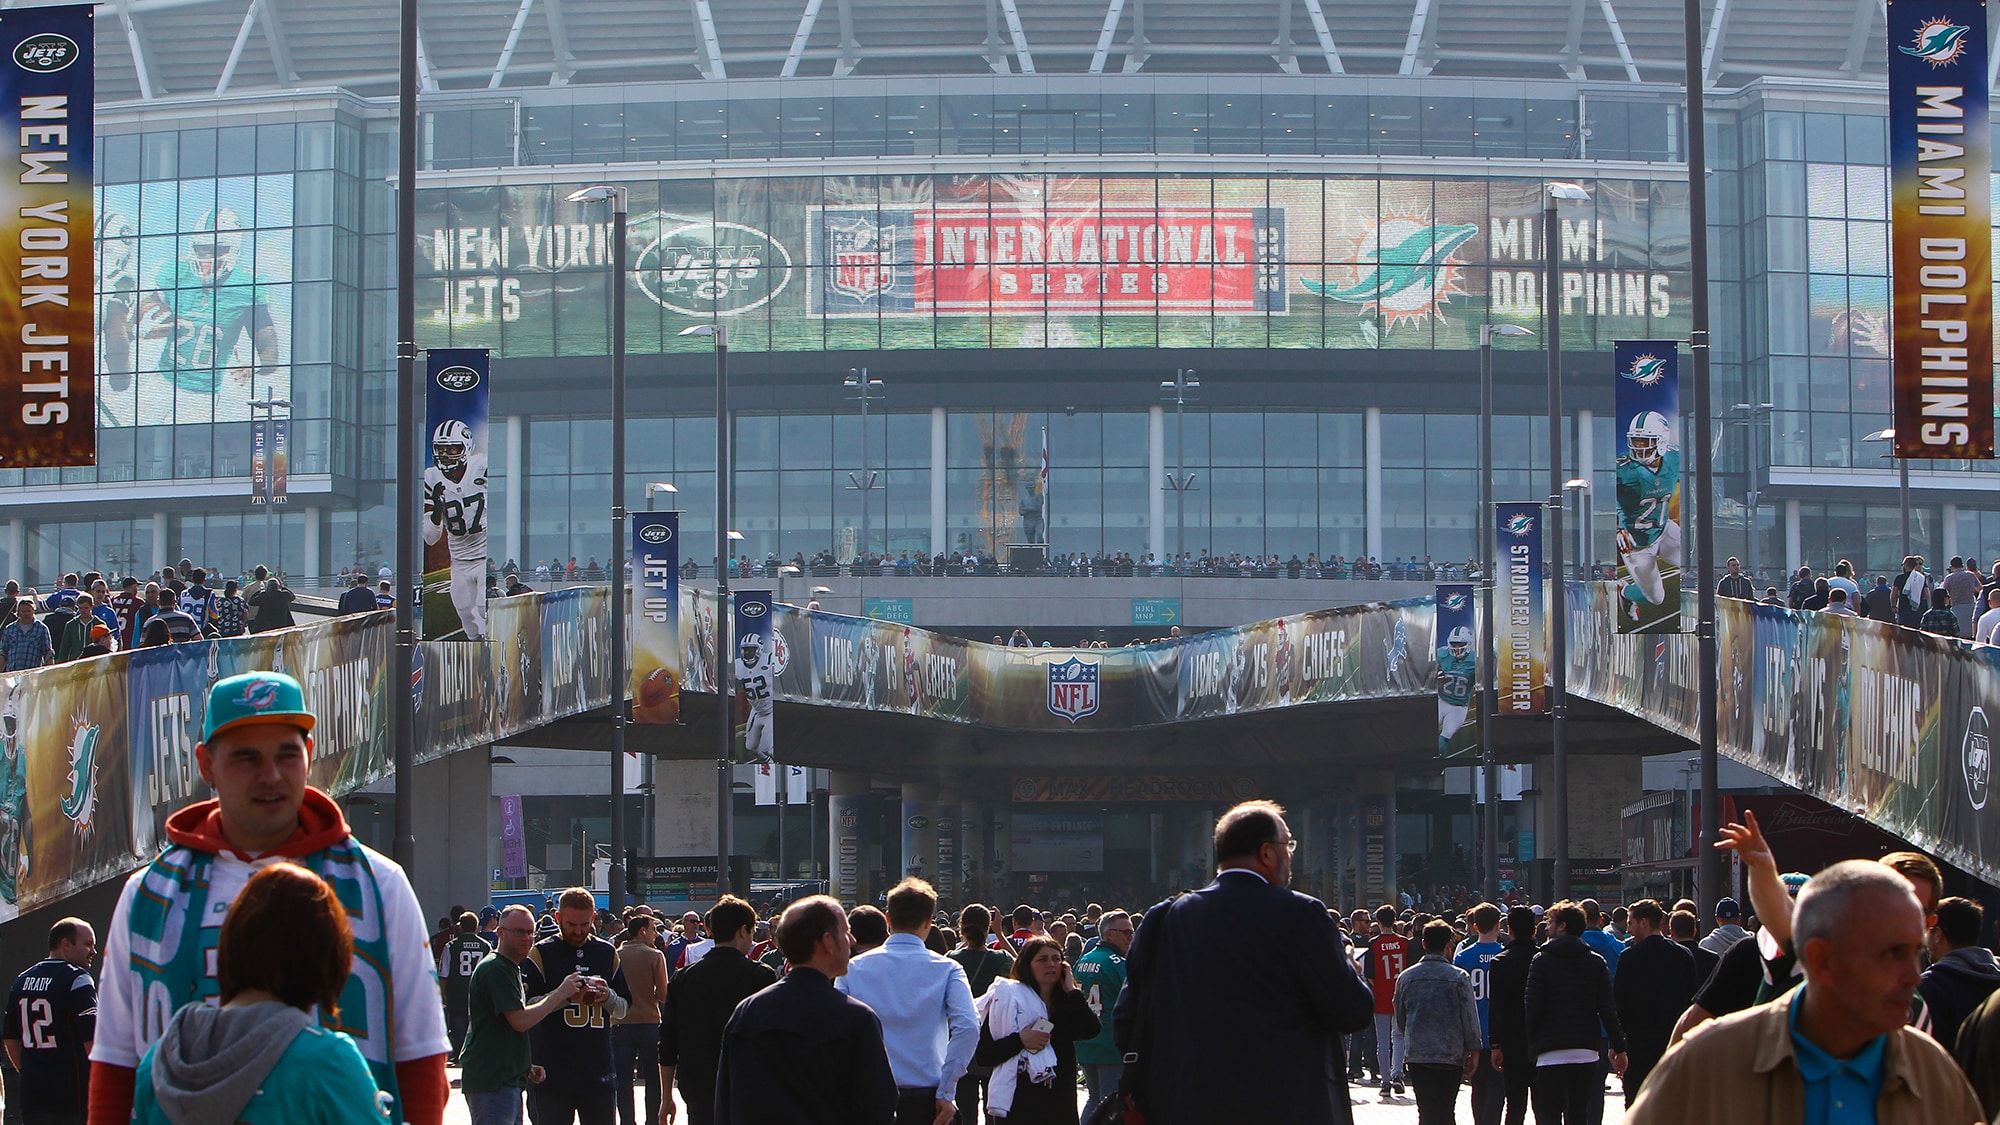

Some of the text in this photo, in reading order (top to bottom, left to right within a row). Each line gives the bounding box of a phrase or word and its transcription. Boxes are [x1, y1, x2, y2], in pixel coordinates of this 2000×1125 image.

[23, 46, 67, 59] JETS
[20, 95, 69, 426] NEW YORK JETS
[433, 222, 614, 271] NEW YORK
[923, 224, 1245, 269] INTERNATIONAL
[1257, 226, 1280, 292] 2015
[1916, 86, 1970, 447] MIAMI DOLPHINS
[661, 255, 762, 281] JETS
[837, 252, 889, 289] NFL
[999, 272, 1170, 295] SERIES
[433, 276, 521, 326] JETS
[443, 372, 472, 384] JETS
[445, 492, 485, 537] 87
[1634, 493, 1672, 530] 21
[644, 530, 667, 538] JETS
[643, 553, 667, 623] JET UP
[886, 604, 903, 612] ABC
[1510, 544, 1532, 711] STRONGER TOGETHER
[824, 636, 957, 701] LIONS VS CHIEFS
[1189, 630, 1345, 699] LIONS VS CHIEFS
[741, 675, 769, 700] 52
[1053, 683, 1094, 713] NFL
[1443, 673, 1469, 698] 26
[1810, 657, 1826, 750] VS
[1861, 665, 1921, 789] DOLPHINS
[149, 694, 193, 807] JETS
[654, 864, 732, 874] GAME DAY FAN PLA
[839, 835, 857, 896] LONDON
[1366, 834, 1385, 894] LONDON
[459, 951, 484, 977] 87
[1381, 942, 1401, 951] EVANS
[1381, 953, 1403, 980] 13
[22, 976, 53, 991] BRADY
[18, 998, 58, 1049] 12
